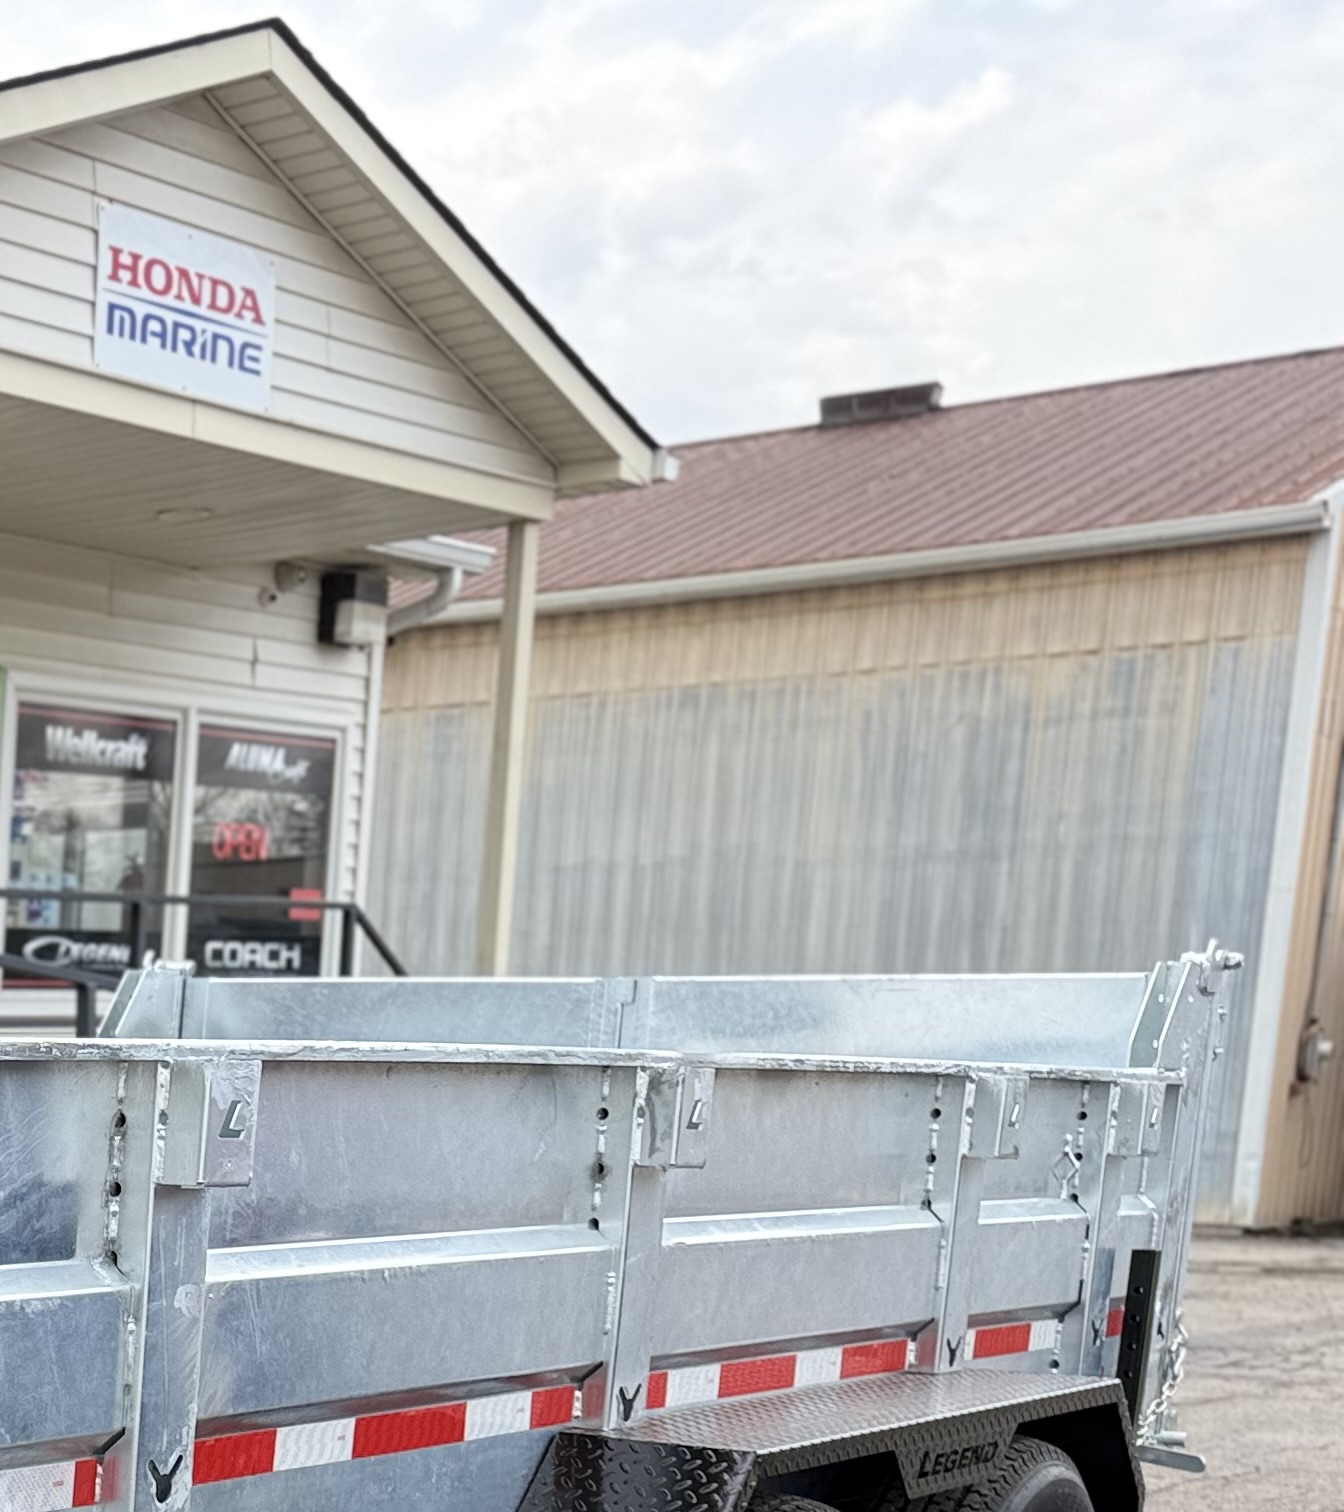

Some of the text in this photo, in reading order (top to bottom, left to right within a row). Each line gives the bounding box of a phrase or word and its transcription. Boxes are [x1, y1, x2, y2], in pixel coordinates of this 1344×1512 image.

[108, 245, 266, 327] HONDA
[106, 302, 263, 377] MARINE
[45, 725, 148, 771] Wellcraft
[204, 939, 302, 971] COACH
[917, 1441, 1000, 1479] LEGEND
